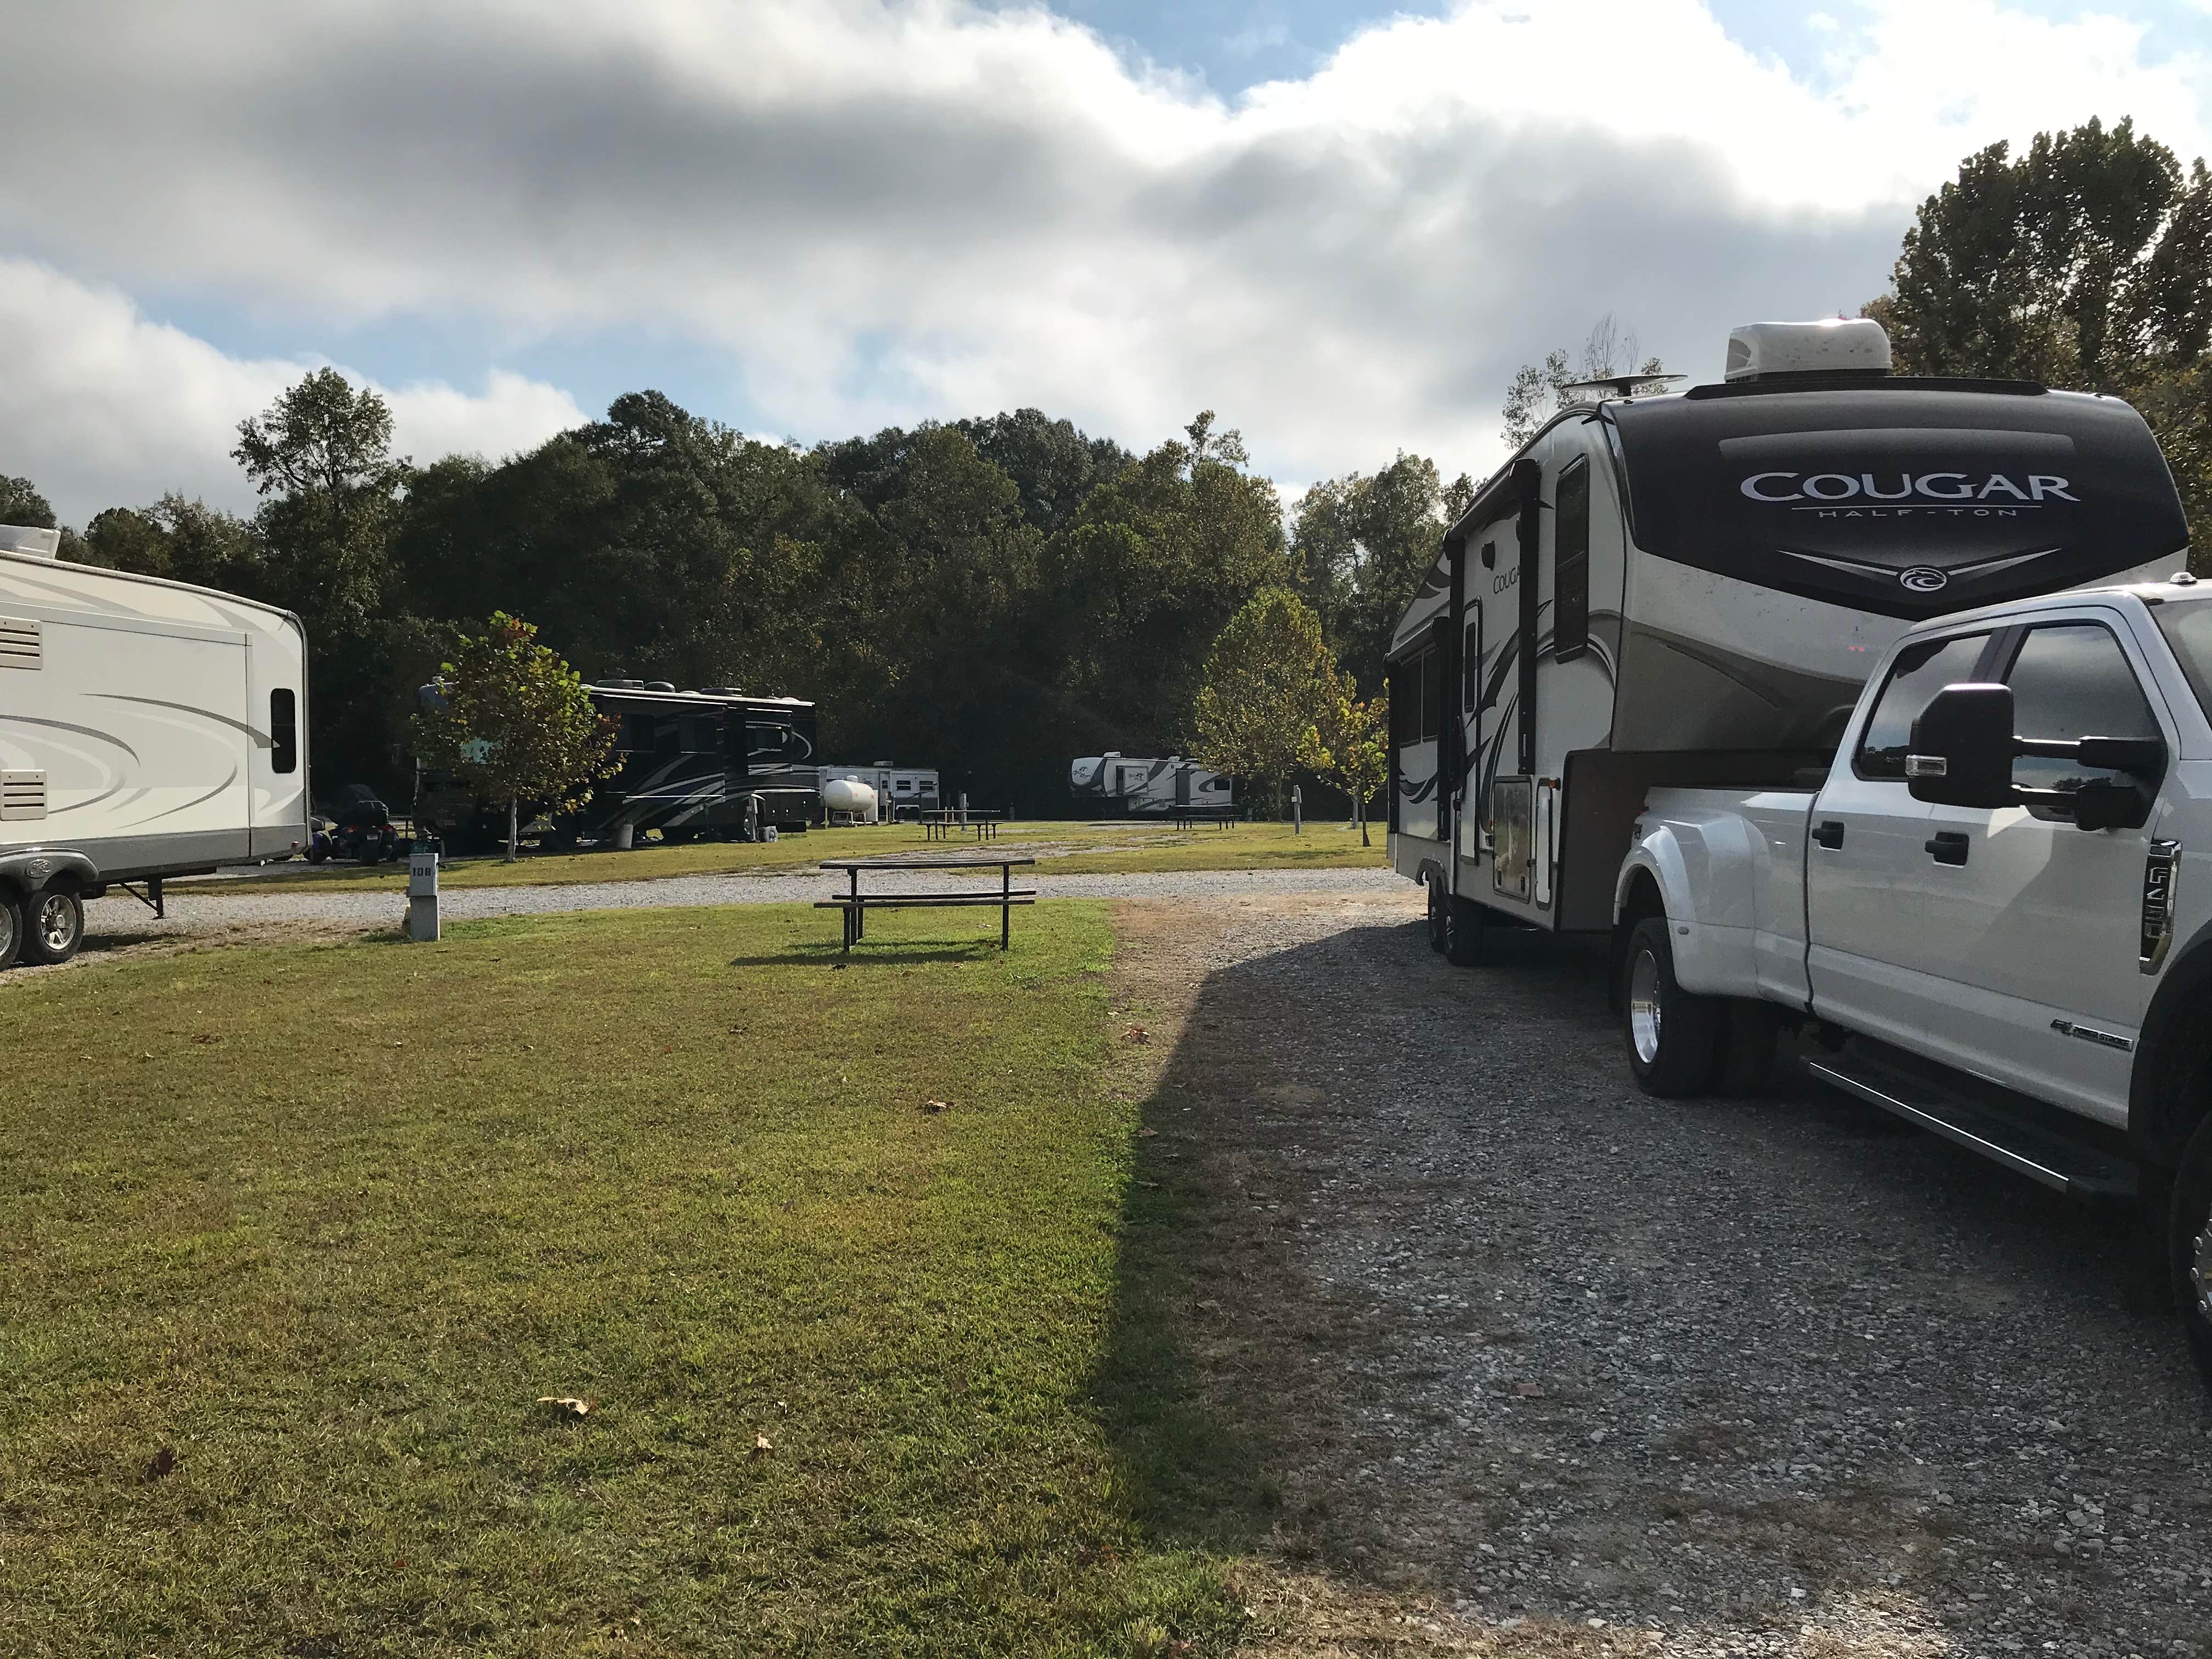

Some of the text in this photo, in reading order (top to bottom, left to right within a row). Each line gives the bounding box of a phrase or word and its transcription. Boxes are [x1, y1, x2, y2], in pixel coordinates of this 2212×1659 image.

[1741, 472, 2081, 501] COUGAR
[1493, 565, 1520, 595] COUGA
[413, 867, 431, 876] 108
